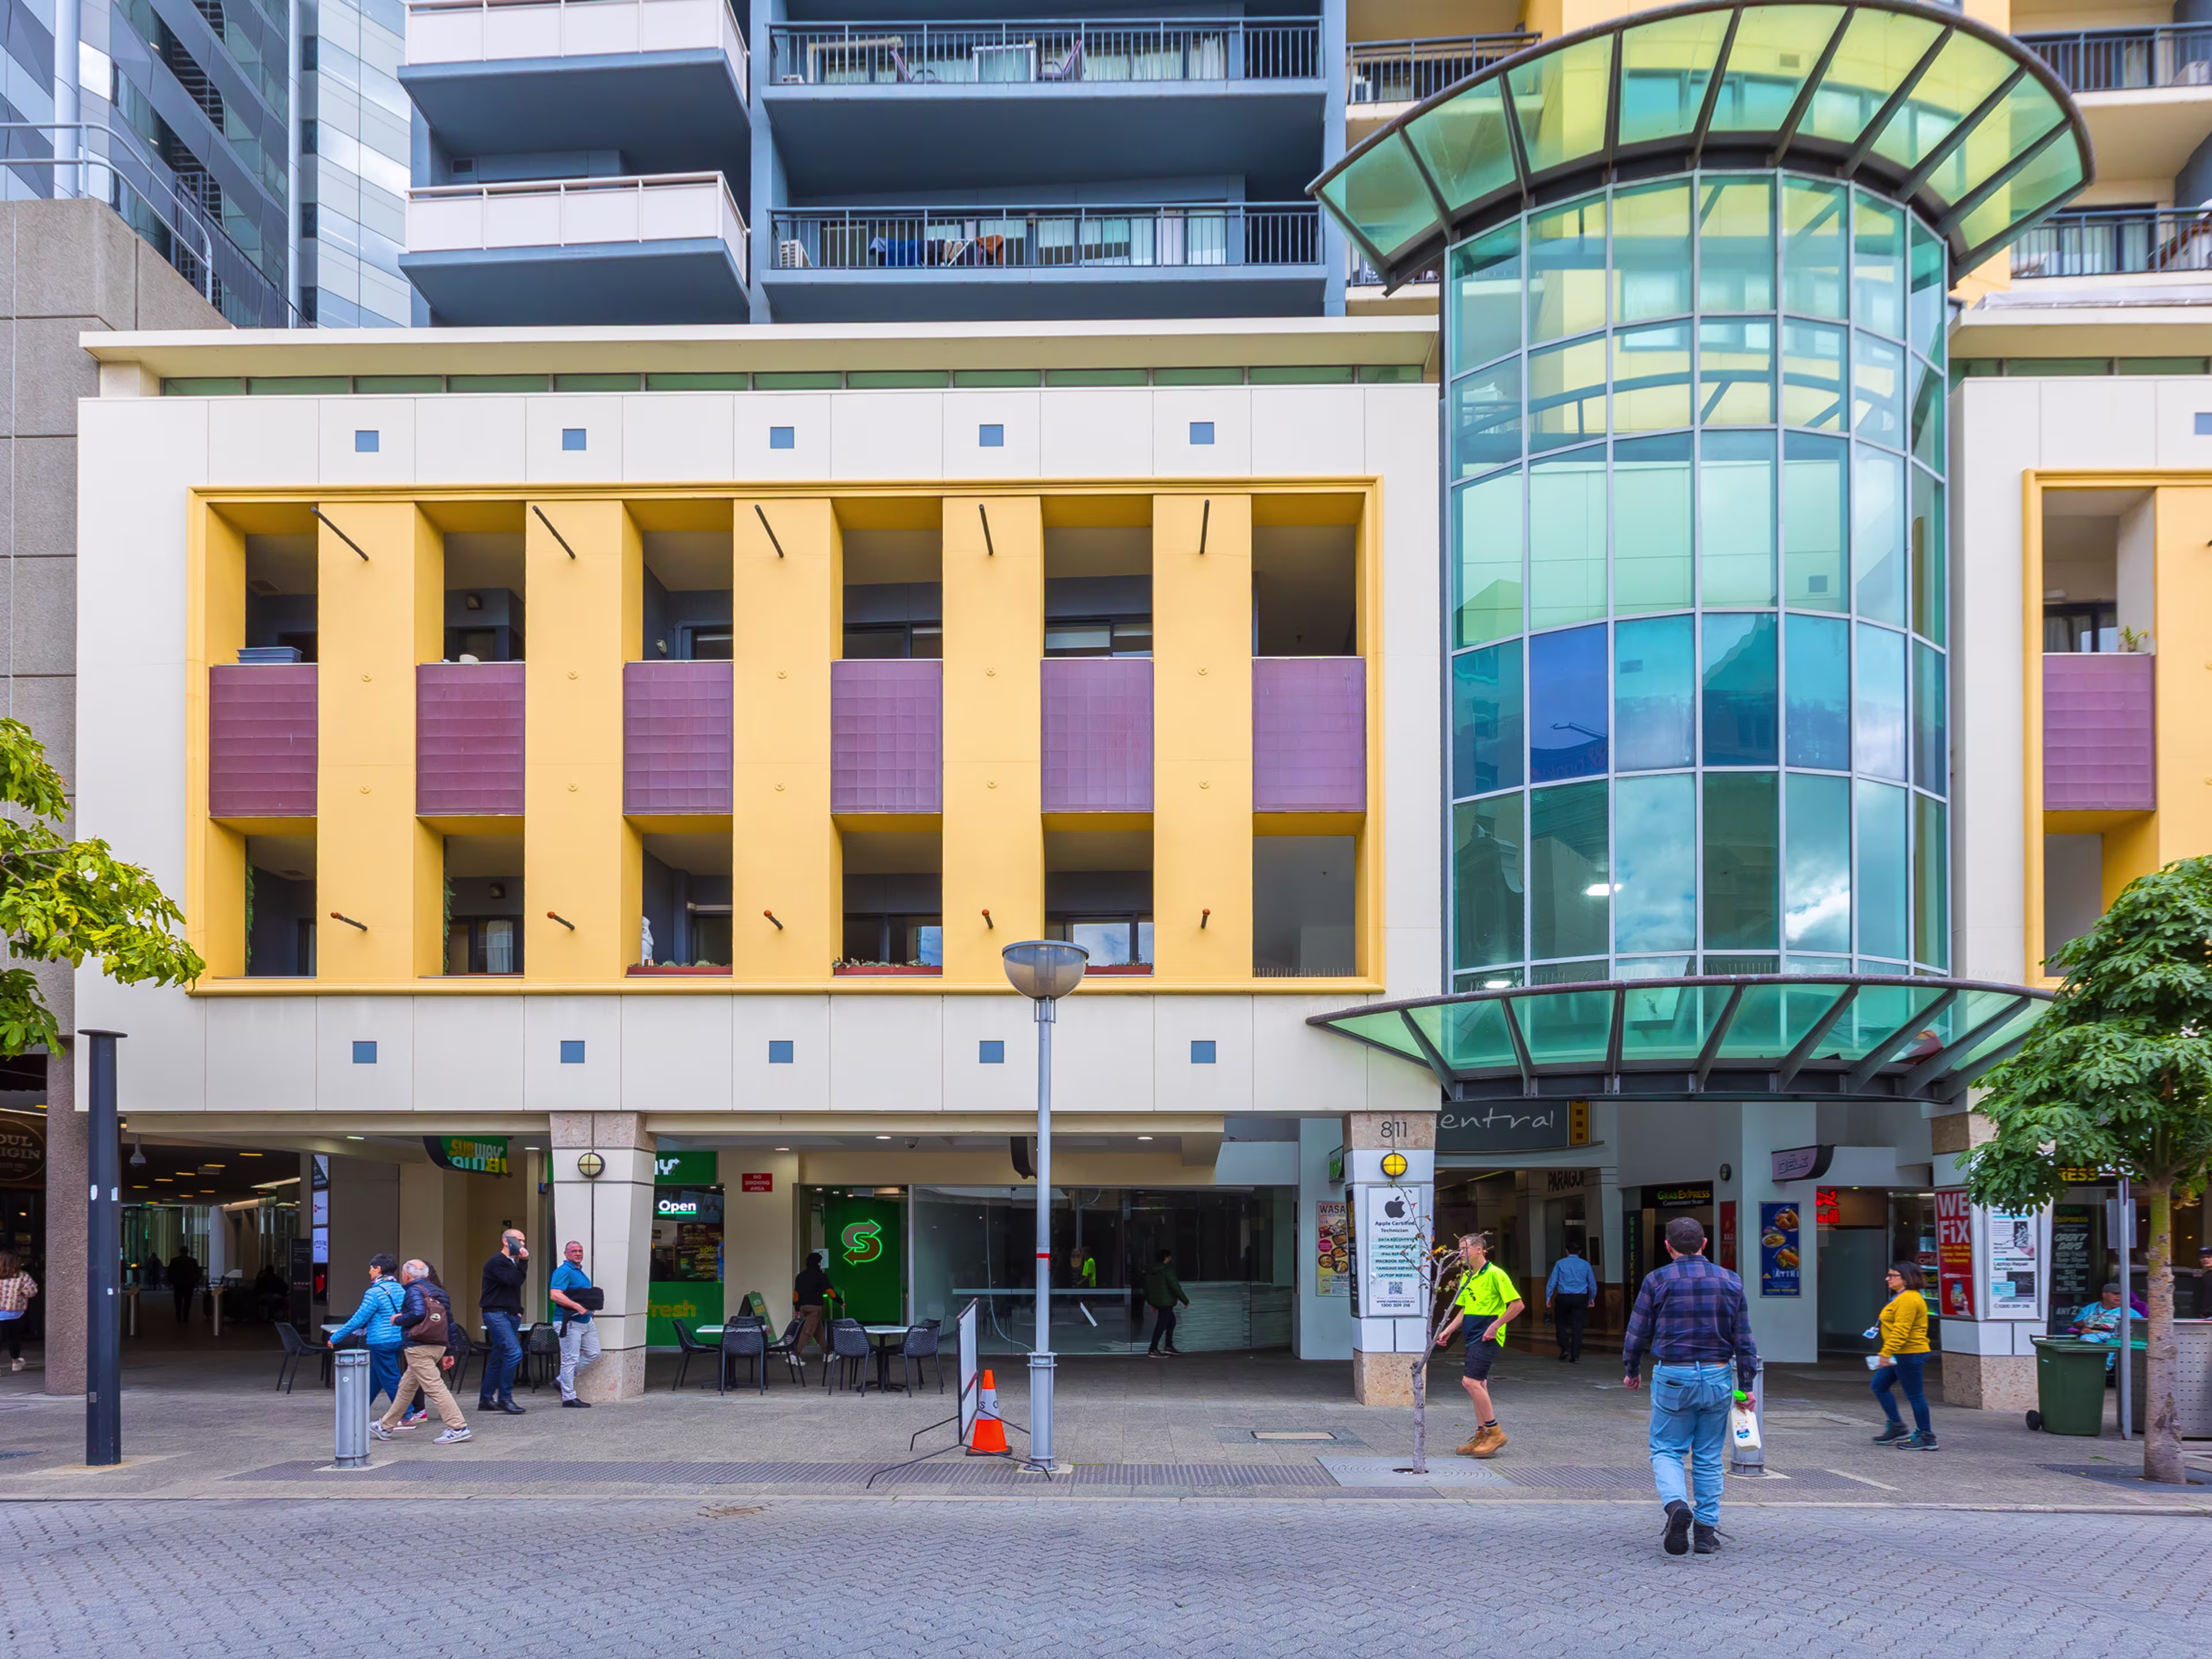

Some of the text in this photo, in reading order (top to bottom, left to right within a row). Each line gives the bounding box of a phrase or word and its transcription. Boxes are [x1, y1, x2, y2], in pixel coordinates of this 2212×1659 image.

[1437, 1107, 1554, 1128] entral
[1381, 1121, 1407, 1138] 811
[0, 1134, 33, 1147] OUL
[0, 1147, 41, 1160] IGIN
[449, 1139, 504, 1160] SUBWAY
[658, 1200, 697, 1214] Open
[1319, 1205, 1346, 1213] WASA
[1937, 1192, 1969, 1217] WE
